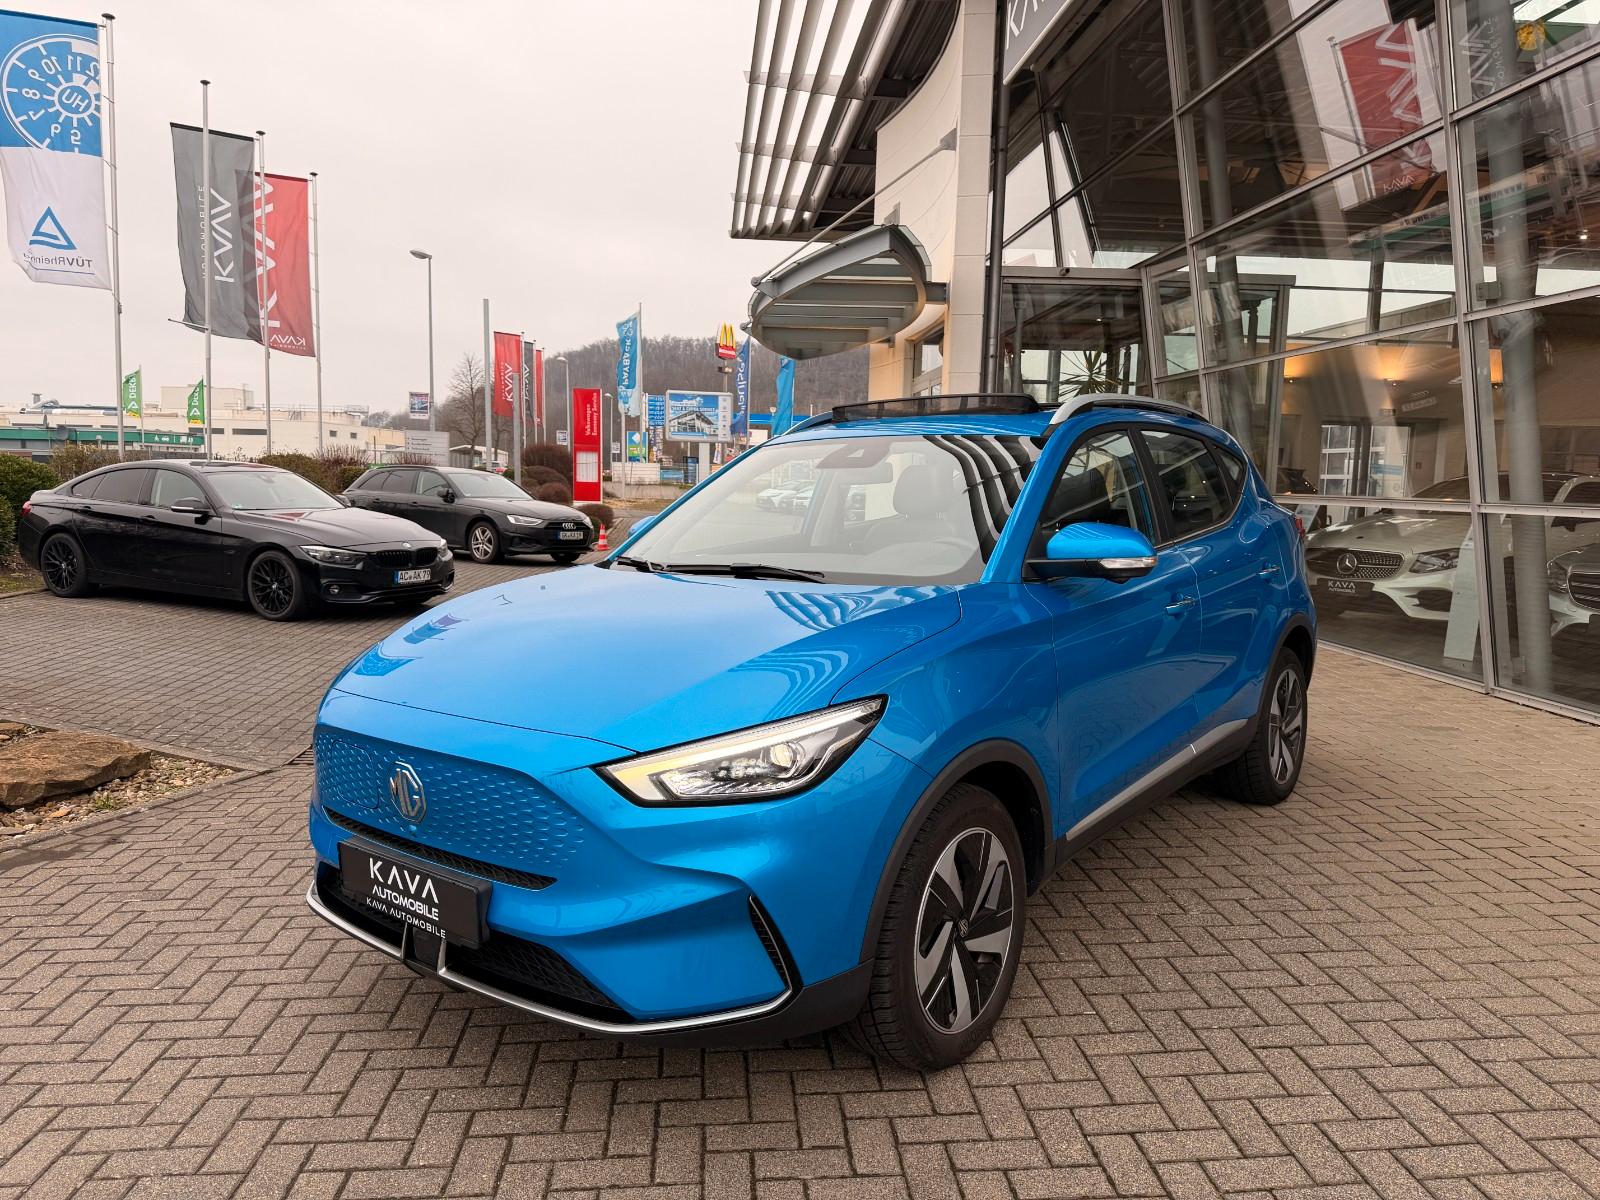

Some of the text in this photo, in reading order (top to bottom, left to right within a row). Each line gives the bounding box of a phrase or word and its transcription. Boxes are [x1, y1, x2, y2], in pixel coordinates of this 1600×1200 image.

[1327, 580, 1356, 589] KAVA
[369, 857, 439, 904] KAVA
[366, 897, 446, 939] KAVA AUTOMOBILE
[372, 884, 439, 921] AUTOMOBILE
